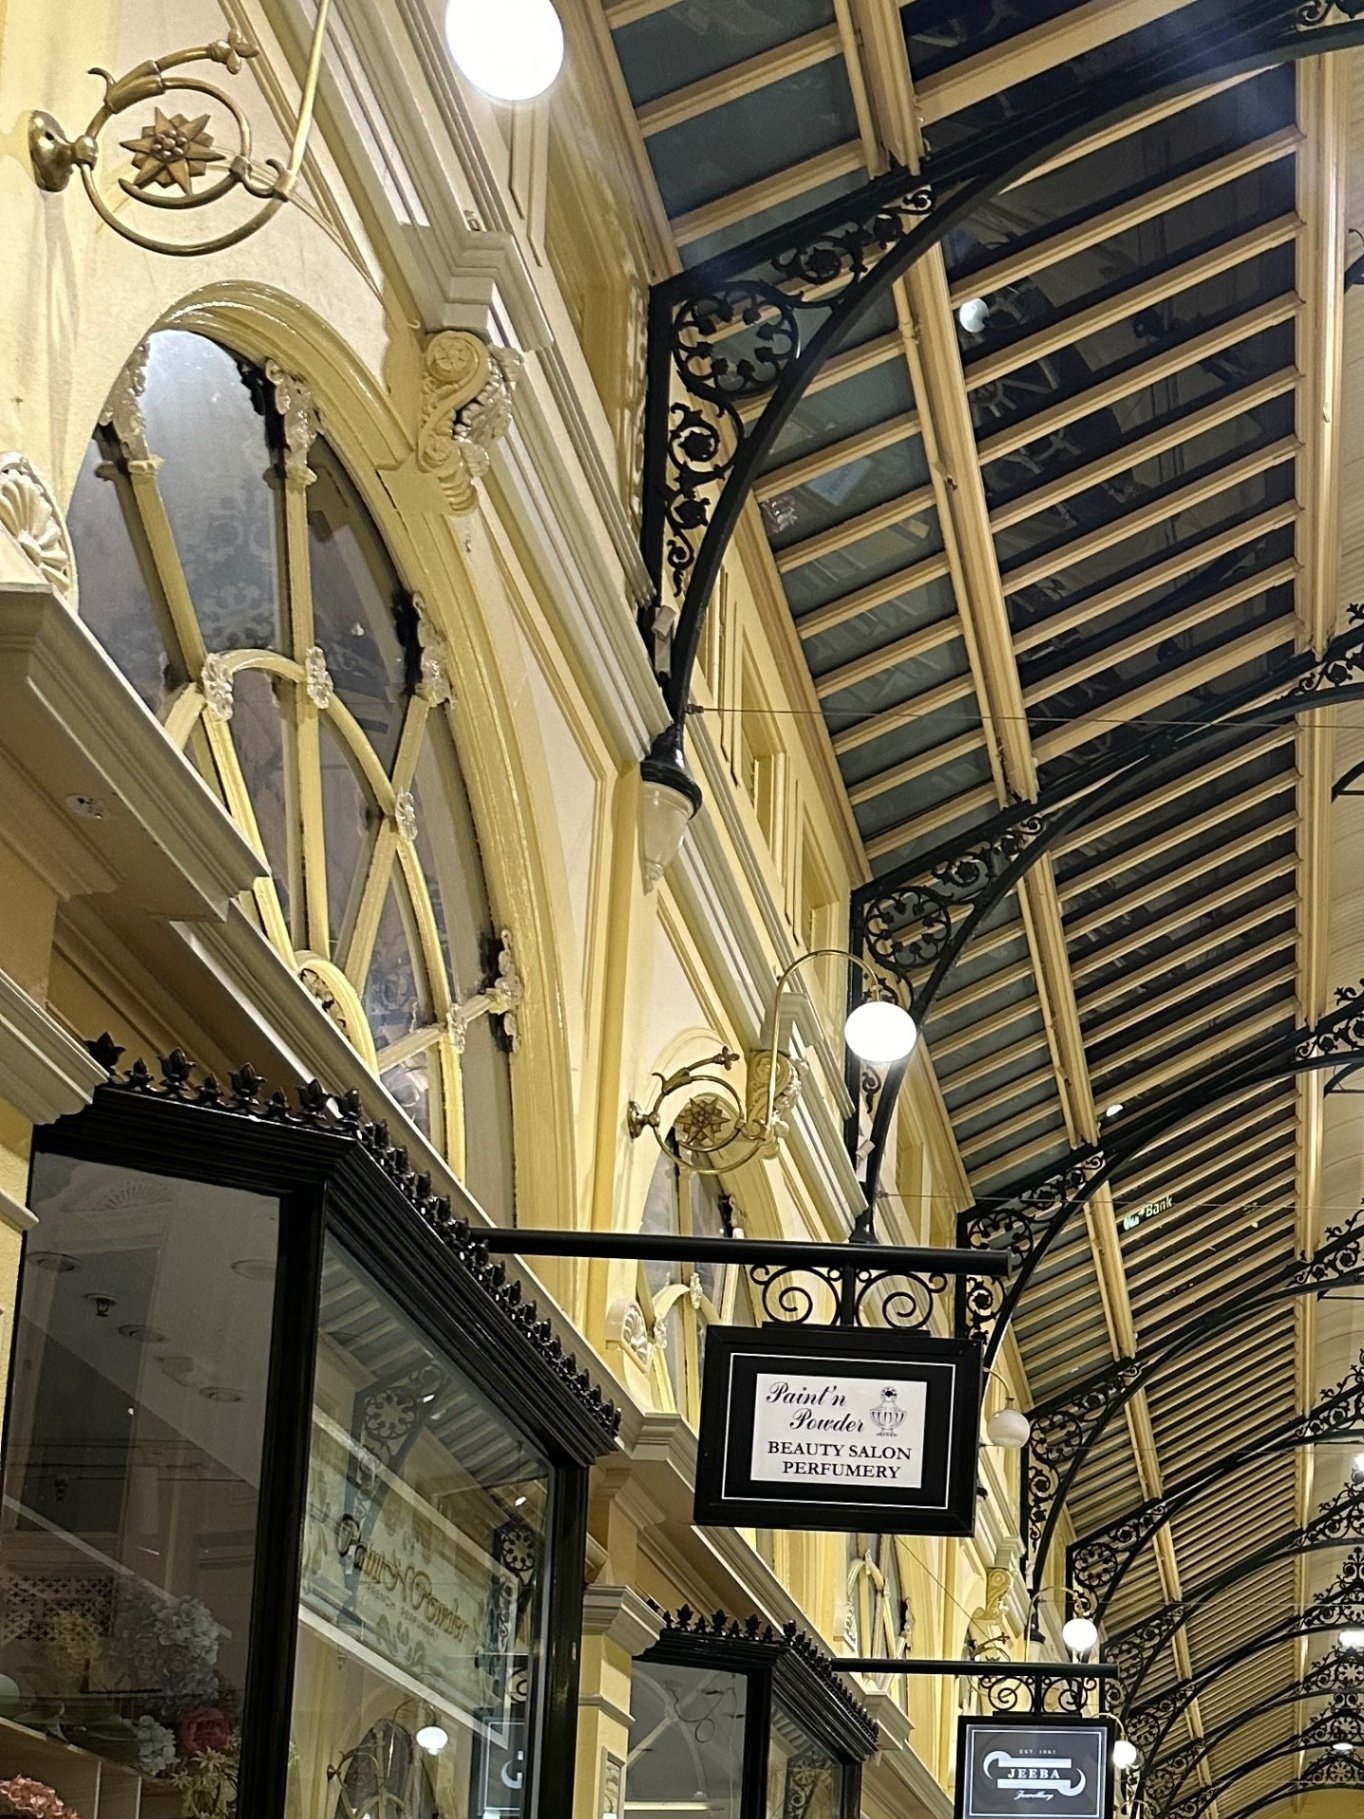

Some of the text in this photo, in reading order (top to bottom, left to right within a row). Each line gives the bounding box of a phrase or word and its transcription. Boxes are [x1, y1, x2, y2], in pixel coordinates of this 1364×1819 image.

[789, 1407, 865, 1433] Powder
[768, 1441, 912, 1461] BEAUTY SALON
[783, 1461, 901, 1479] PERFUMERY
[1007, 1768, 1060, 1779] JEEBA
[1013, 1789, 1055, 1801] Jewellery
